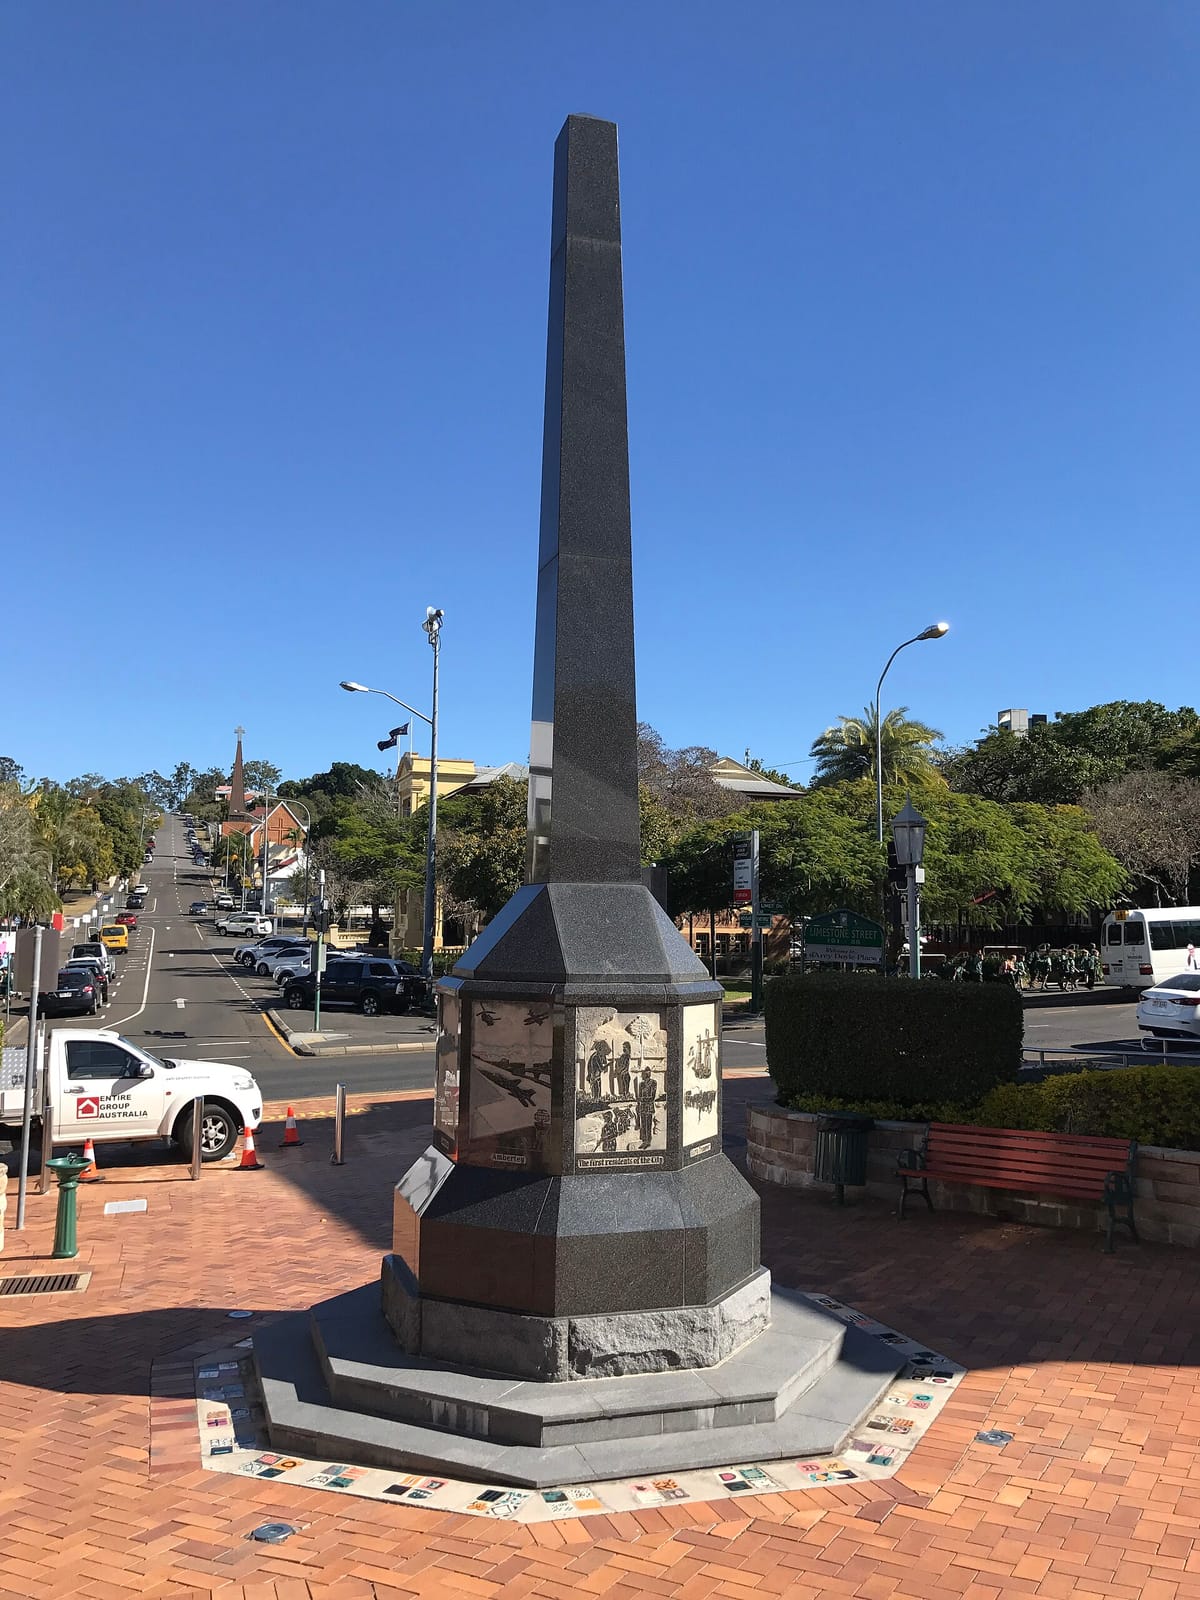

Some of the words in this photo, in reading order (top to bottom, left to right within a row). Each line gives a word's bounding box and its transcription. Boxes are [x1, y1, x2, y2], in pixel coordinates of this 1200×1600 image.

[809, 927, 849, 939] LIMESTONE
[851, 929, 878, 940] STREET
[100, 1094, 132, 1102] ENTIRE
[99, 1111, 148, 1119] AUSTRALIA
[578, 1158, 590, 1167] The
[590, 1158, 604, 1167] first
[605, 1157, 633, 1165] residents
[641, 1156, 651, 1164] the
